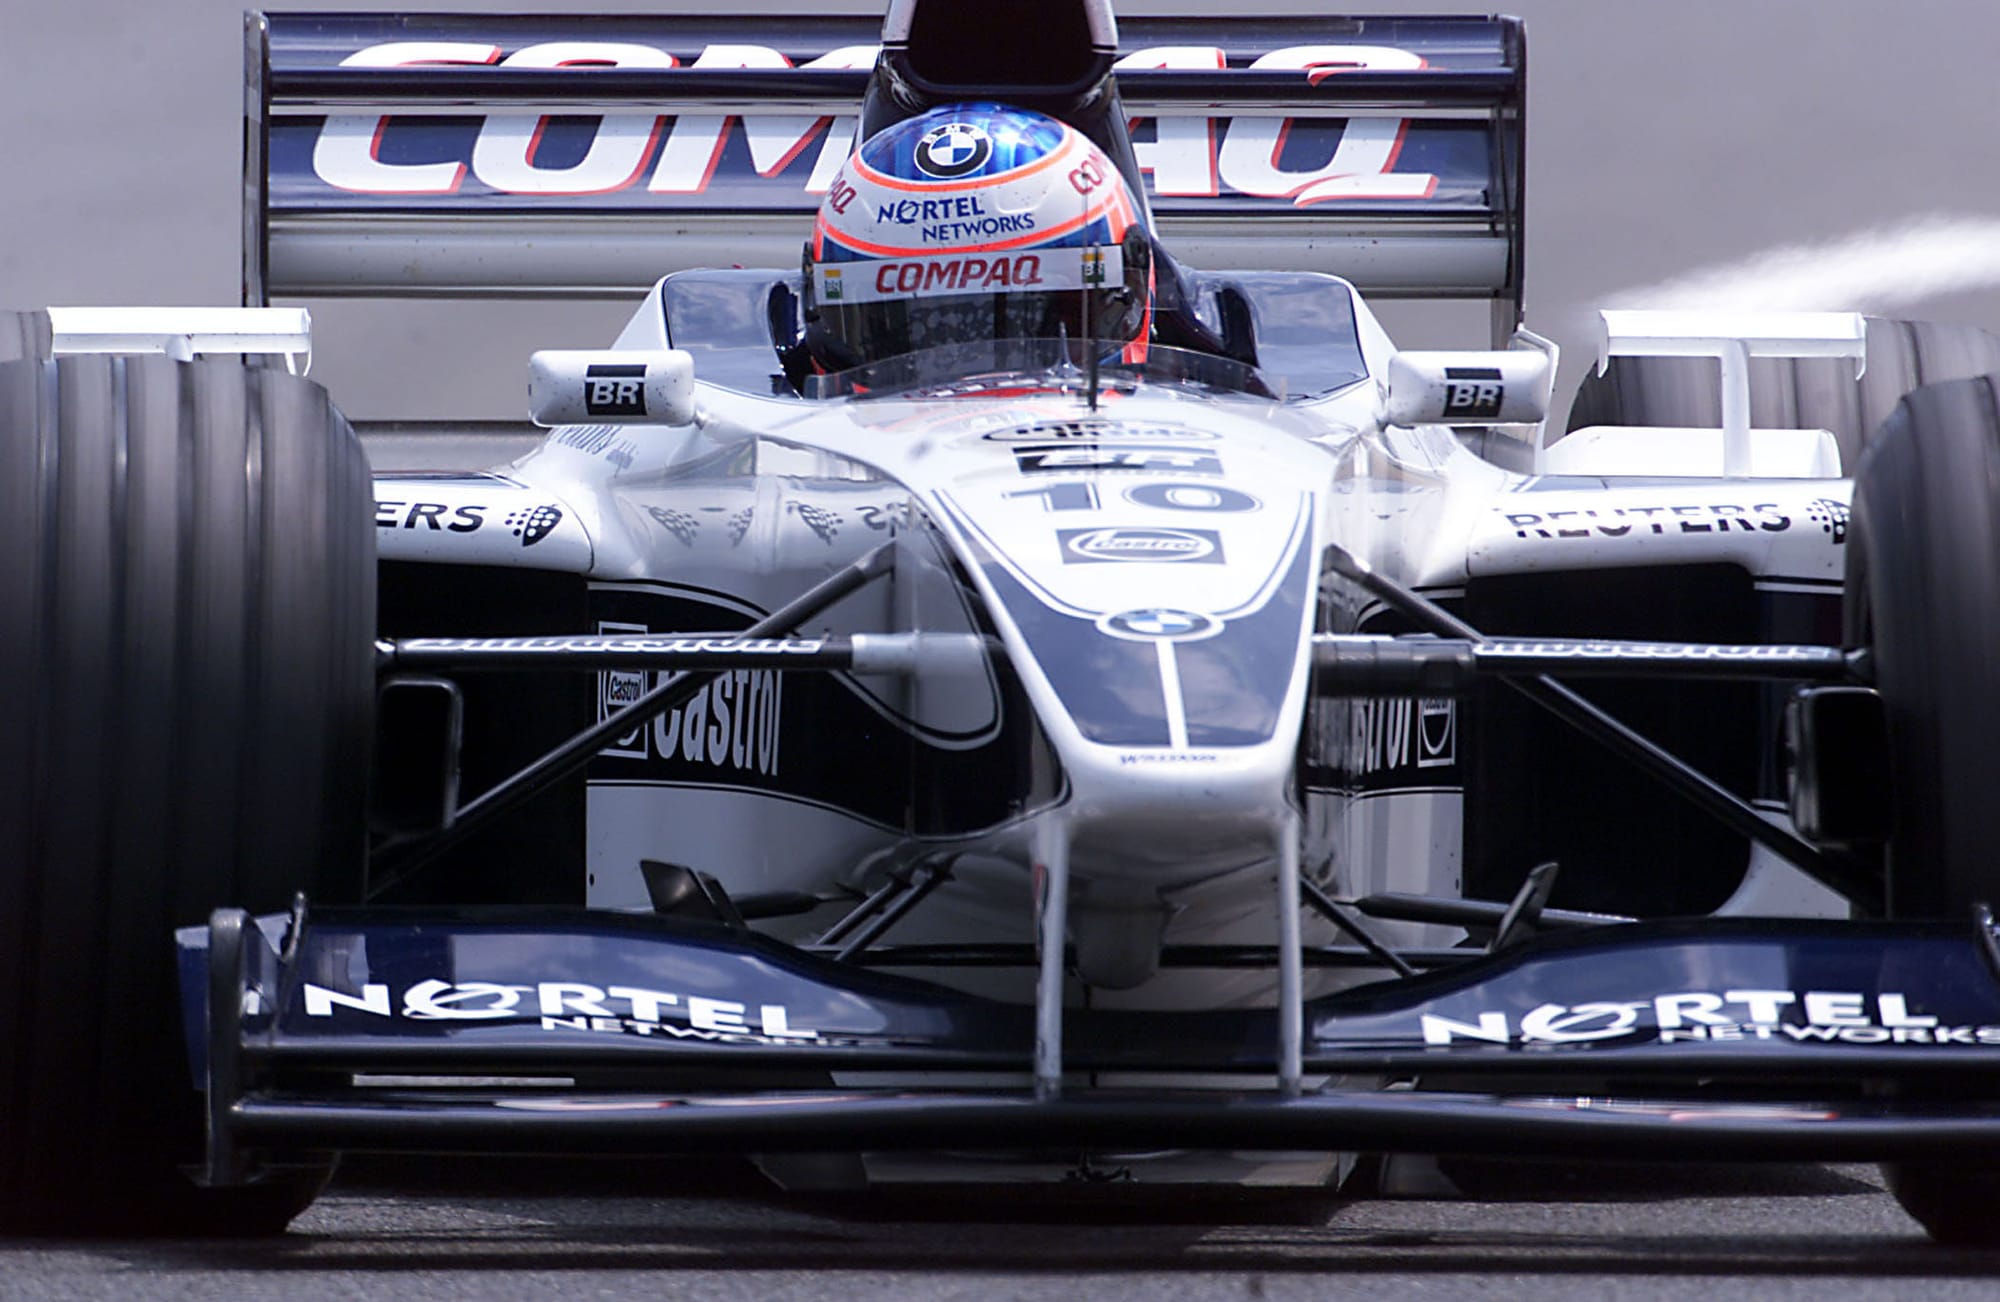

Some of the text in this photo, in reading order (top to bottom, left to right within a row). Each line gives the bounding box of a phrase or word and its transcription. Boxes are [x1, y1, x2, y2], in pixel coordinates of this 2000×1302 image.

[313, 42, 1439, 206] COMAQ
[876, 196, 985, 225] NORTEL
[922, 213, 1035, 243] NETWORKS
[875, 255, 1043, 294] COMPAQ
[590, 380, 638, 405] BR
[1450, 384, 1498, 408] BR
[1001, 481, 1264, 513] 10
[1504, 502, 1791, 539] REUTERS
[303, 979, 818, 1038] NORTEL
[1420, 990, 1938, 1046] NORTEL
[1659, 1023, 2000, 1045] NETWORKS
